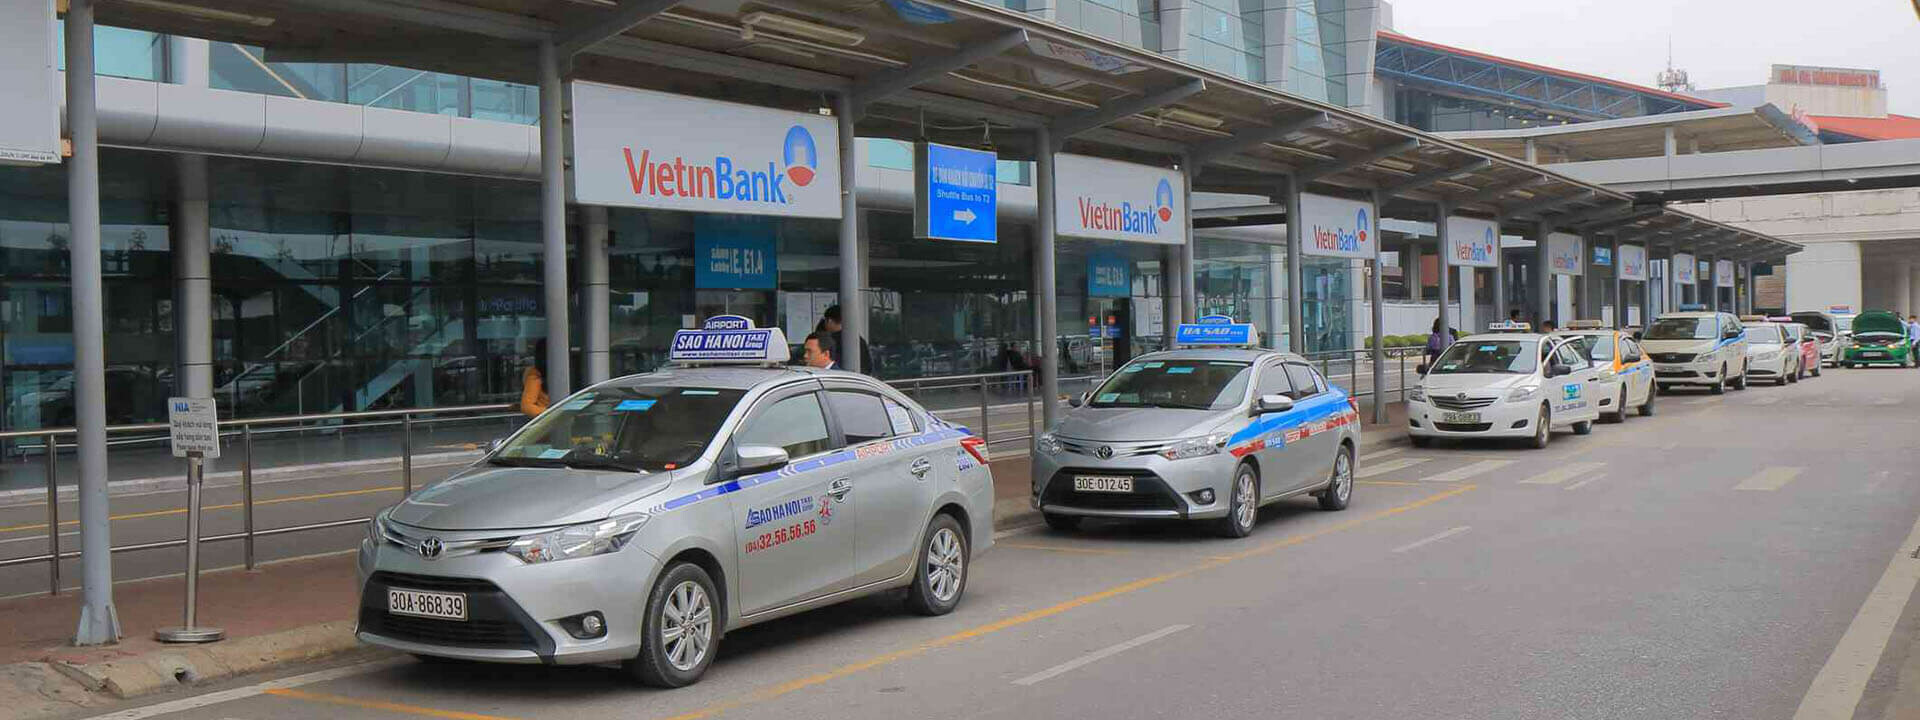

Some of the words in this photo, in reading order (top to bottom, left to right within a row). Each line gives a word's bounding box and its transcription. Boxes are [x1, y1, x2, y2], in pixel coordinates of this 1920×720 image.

[623, 147, 786, 205] VietinBank
[936, 188, 960, 200] Shuttle
[961, 191, 974, 202] Bus
[974, 193, 982, 203] to
[983, 193, 991, 204] T2
[1078, 196, 1158, 235] VietinBank
[1313, 225, 1359, 252] VietinBank
[704, 319, 745, 330] AIRPORT
[677, 334, 703, 350] SAO
[704, 333, 747, 350] HANOI
[747, 333, 766, 341] TAXI
[773, 500, 802, 521] HANOI
[800, 496, 814, 504] TAXI
[391, 590, 464, 616] 30A-868.39
